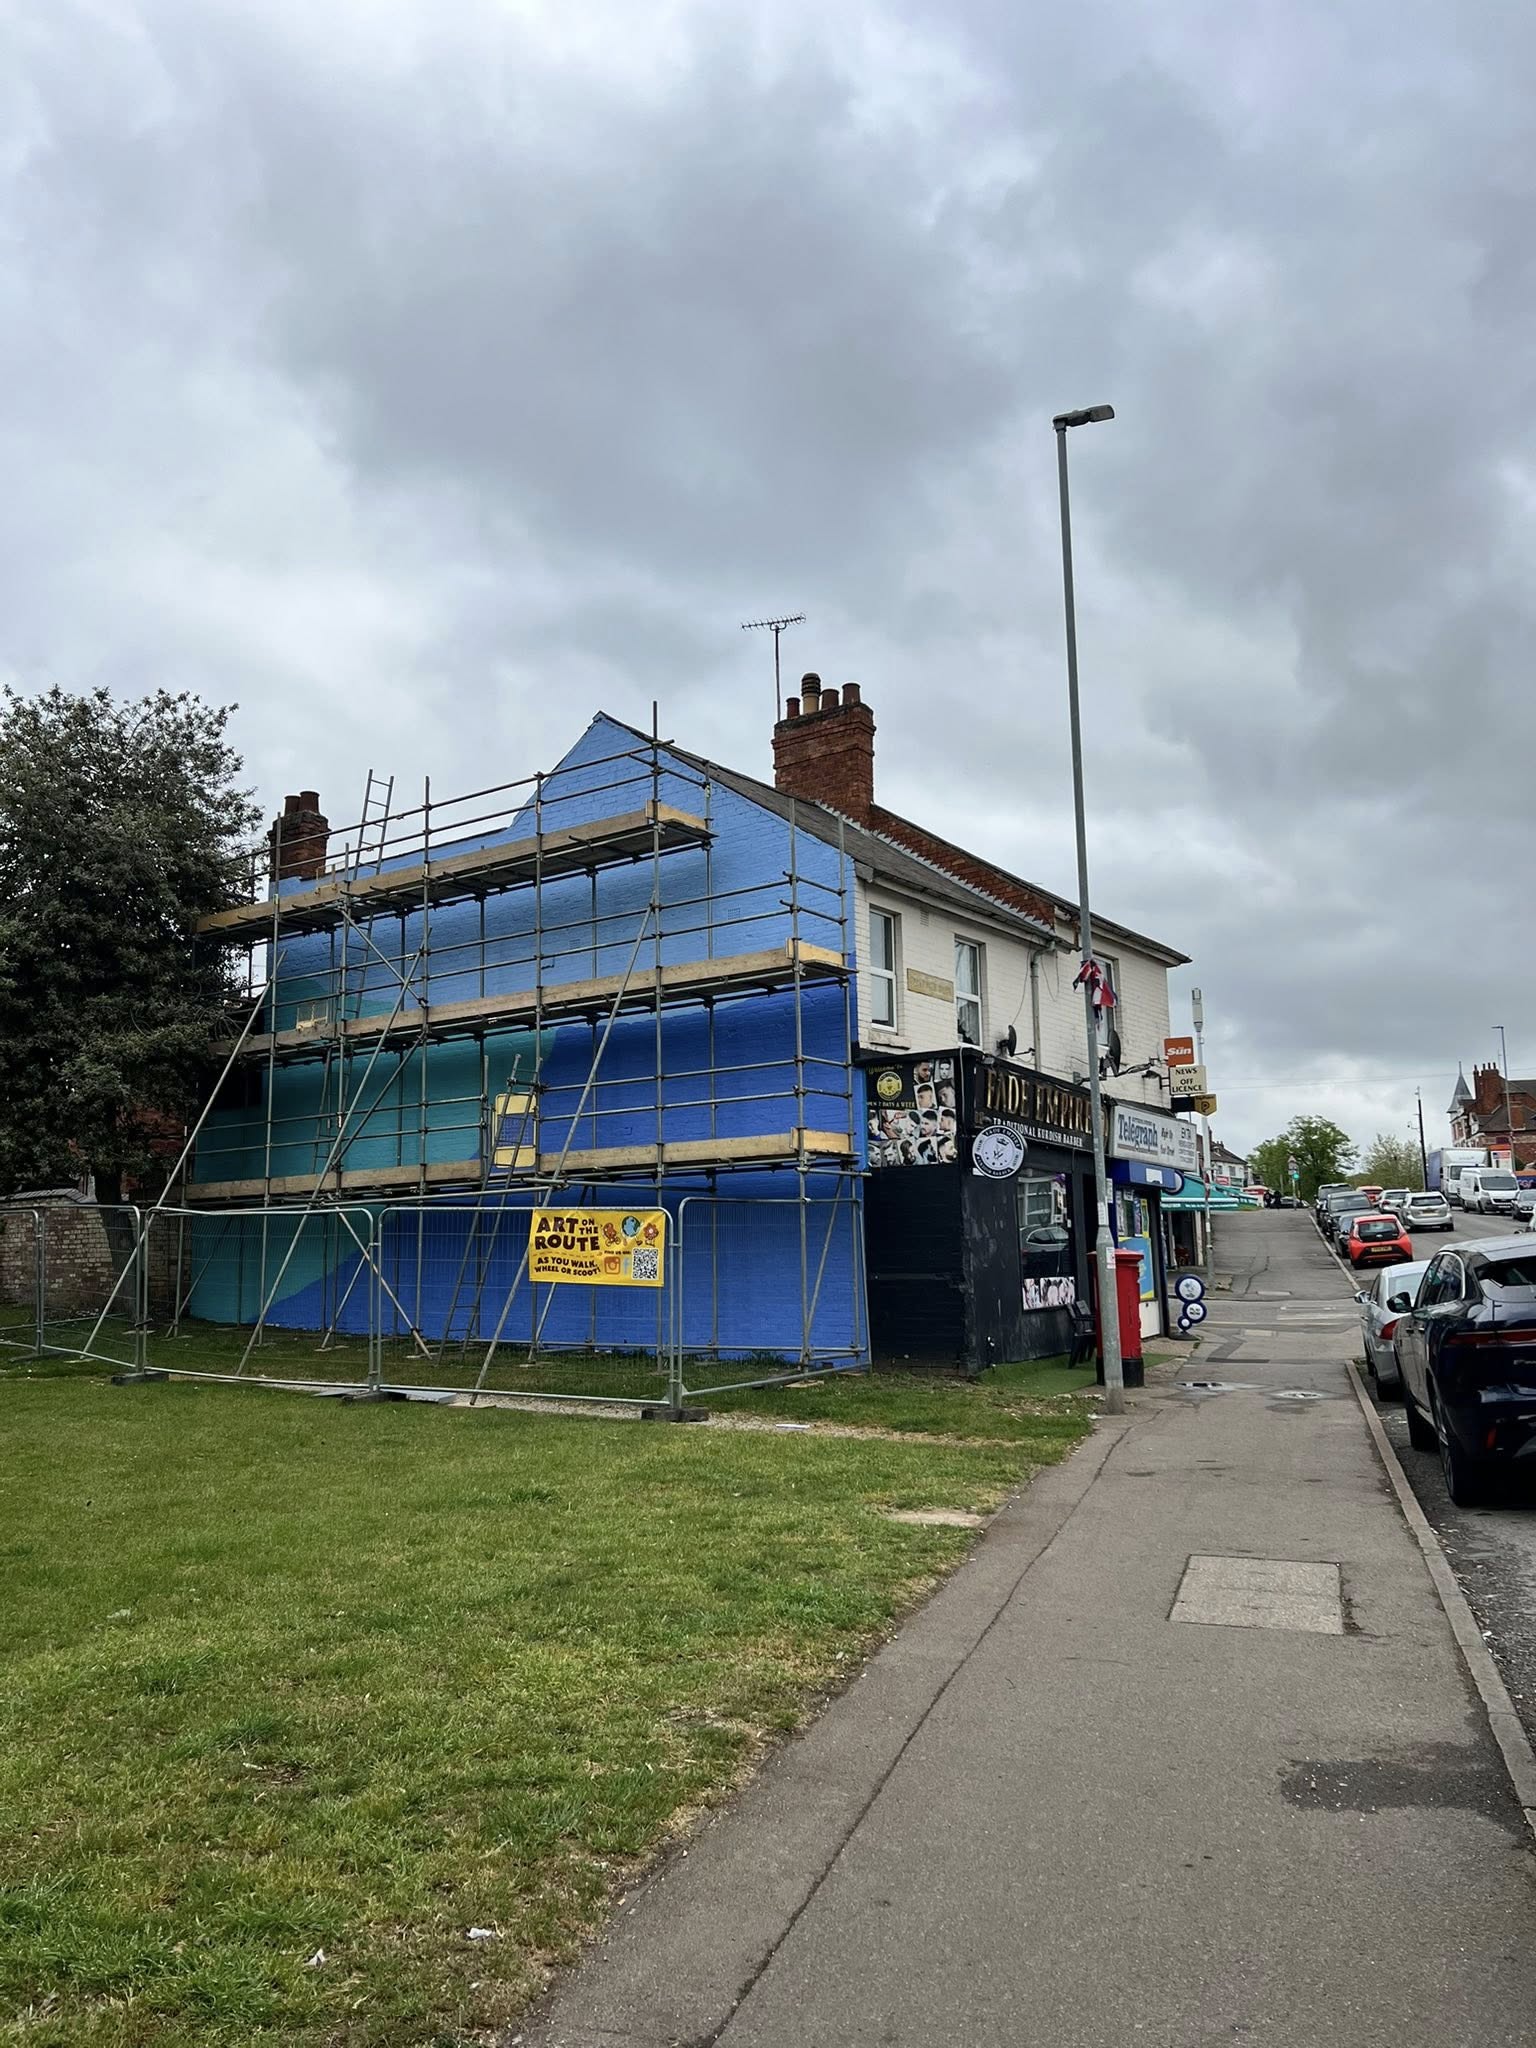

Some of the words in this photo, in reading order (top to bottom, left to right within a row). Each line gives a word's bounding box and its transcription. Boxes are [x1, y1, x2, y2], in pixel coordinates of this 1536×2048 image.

[1166, 1047, 1192, 1056] Sun
[1180, 1078, 1194, 1086] OFF
[1172, 1085, 1203, 1093] LICENCE
[986, 1067, 1030, 1117] FADE
[1035, 1083, 1092, 1134] EMPIRE
[993, 1118, 1036, 1137] TRADITIONAL
[1037, 1127, 1062, 1143] KURDISH
[1063, 1135, 1083, 1147] BARBER
[1117, 1113, 1158, 1152] Telegraph
[537, 1216, 579, 1233] ART
[582, 1218, 595, 1226] ON
[579, 1227, 599, 1235] THE
[535, 1234, 600, 1252] ROUTE
[551, 1257, 570, 1266] YOU
[534, 1265, 560, 1273] WHEEL
[561, 1267, 572, 1275] OR
